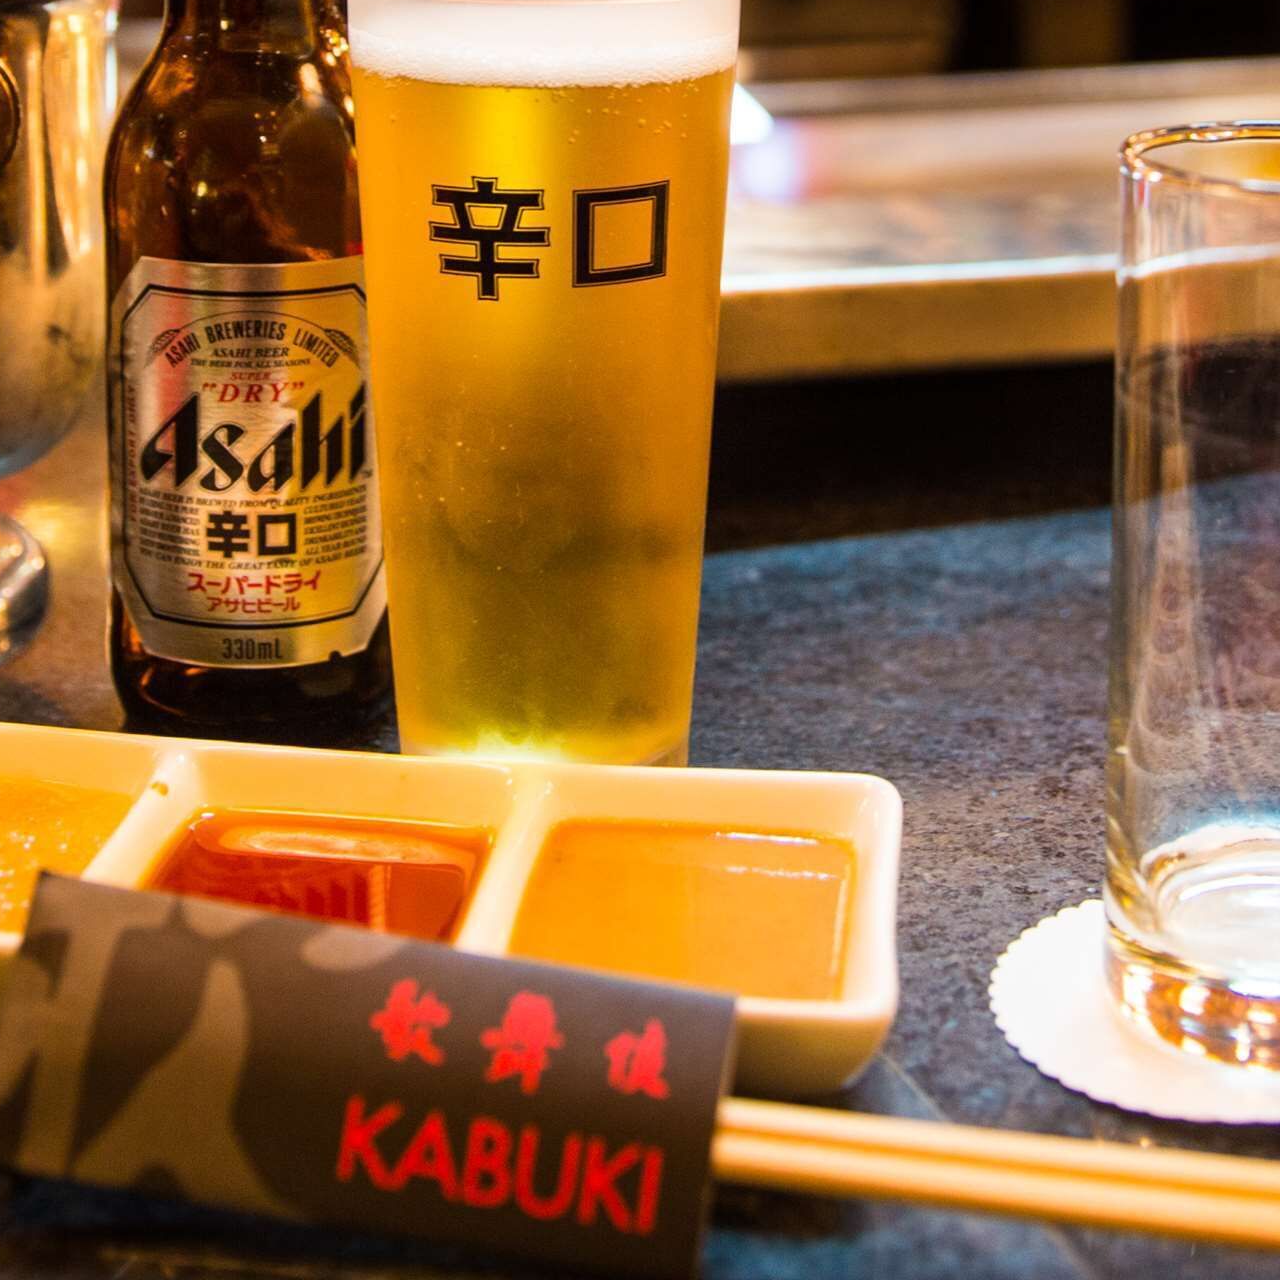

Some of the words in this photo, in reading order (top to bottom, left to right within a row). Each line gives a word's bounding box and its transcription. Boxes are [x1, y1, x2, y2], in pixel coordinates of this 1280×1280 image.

[428, 175, 670, 301] 辛口
[165, 332, 201, 368] ASAHI
[205, 319, 287, 344] BREWERIES
[292, 328, 340, 368] LIMITED
[211, 347, 252, 358] ASAHI
[254, 347, 289, 358] BEER
[229, 372, 272, 382] SUPER
[140, 381, 367, 492] Asahi
[206, 510, 298, 559] 辛口
[187, 570, 322, 595] スーパードライ
[206, 597, 302, 614] アサヒビール
[335, 1094, 664, 1236] KABUKI
